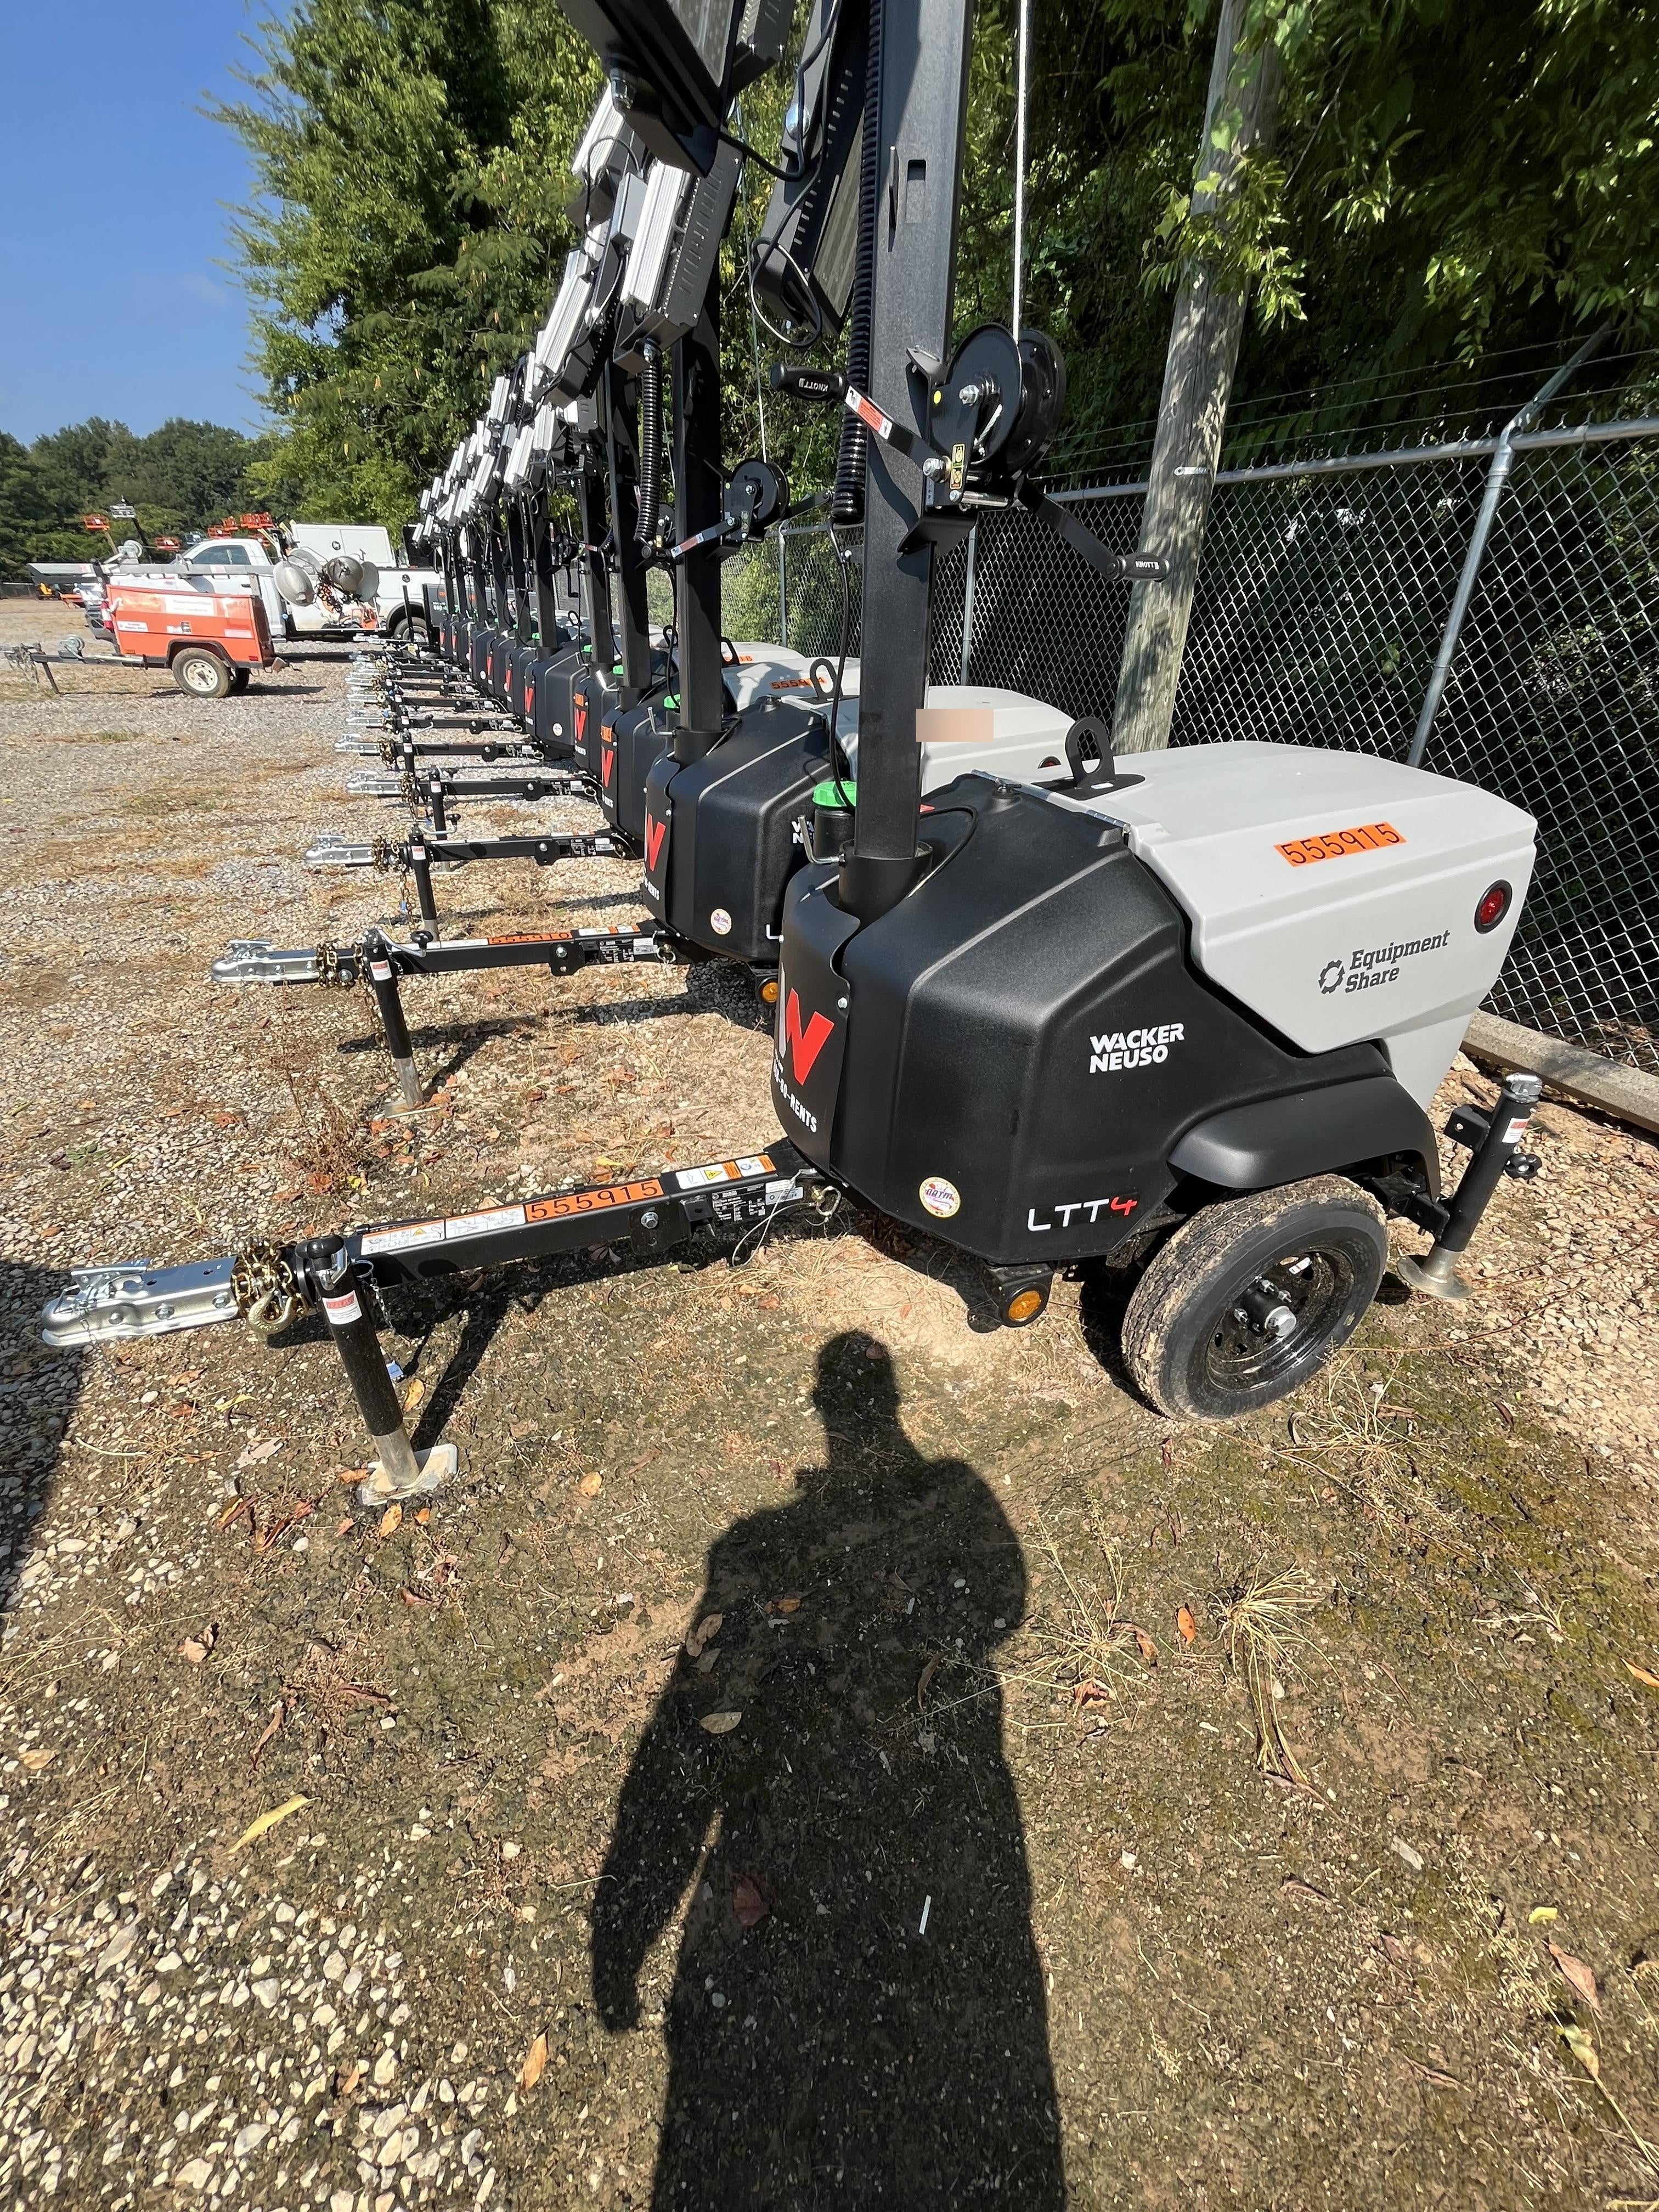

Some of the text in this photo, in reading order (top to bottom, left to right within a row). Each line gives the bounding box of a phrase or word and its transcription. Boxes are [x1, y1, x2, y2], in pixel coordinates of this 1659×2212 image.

[1280, 824, 1400, 864] 555915
[492, 933, 569, 944] 555910
[1350, 930, 1450, 971] Equipment
[1345, 967, 1400, 993] Share
[1090, 1023, 1185, 1054] WACKER
[1090, 1045, 1169, 1073] NEUSO
[531, 1182, 658, 1218] 555915
[1028, 1197, 1137, 1231] LTT4
